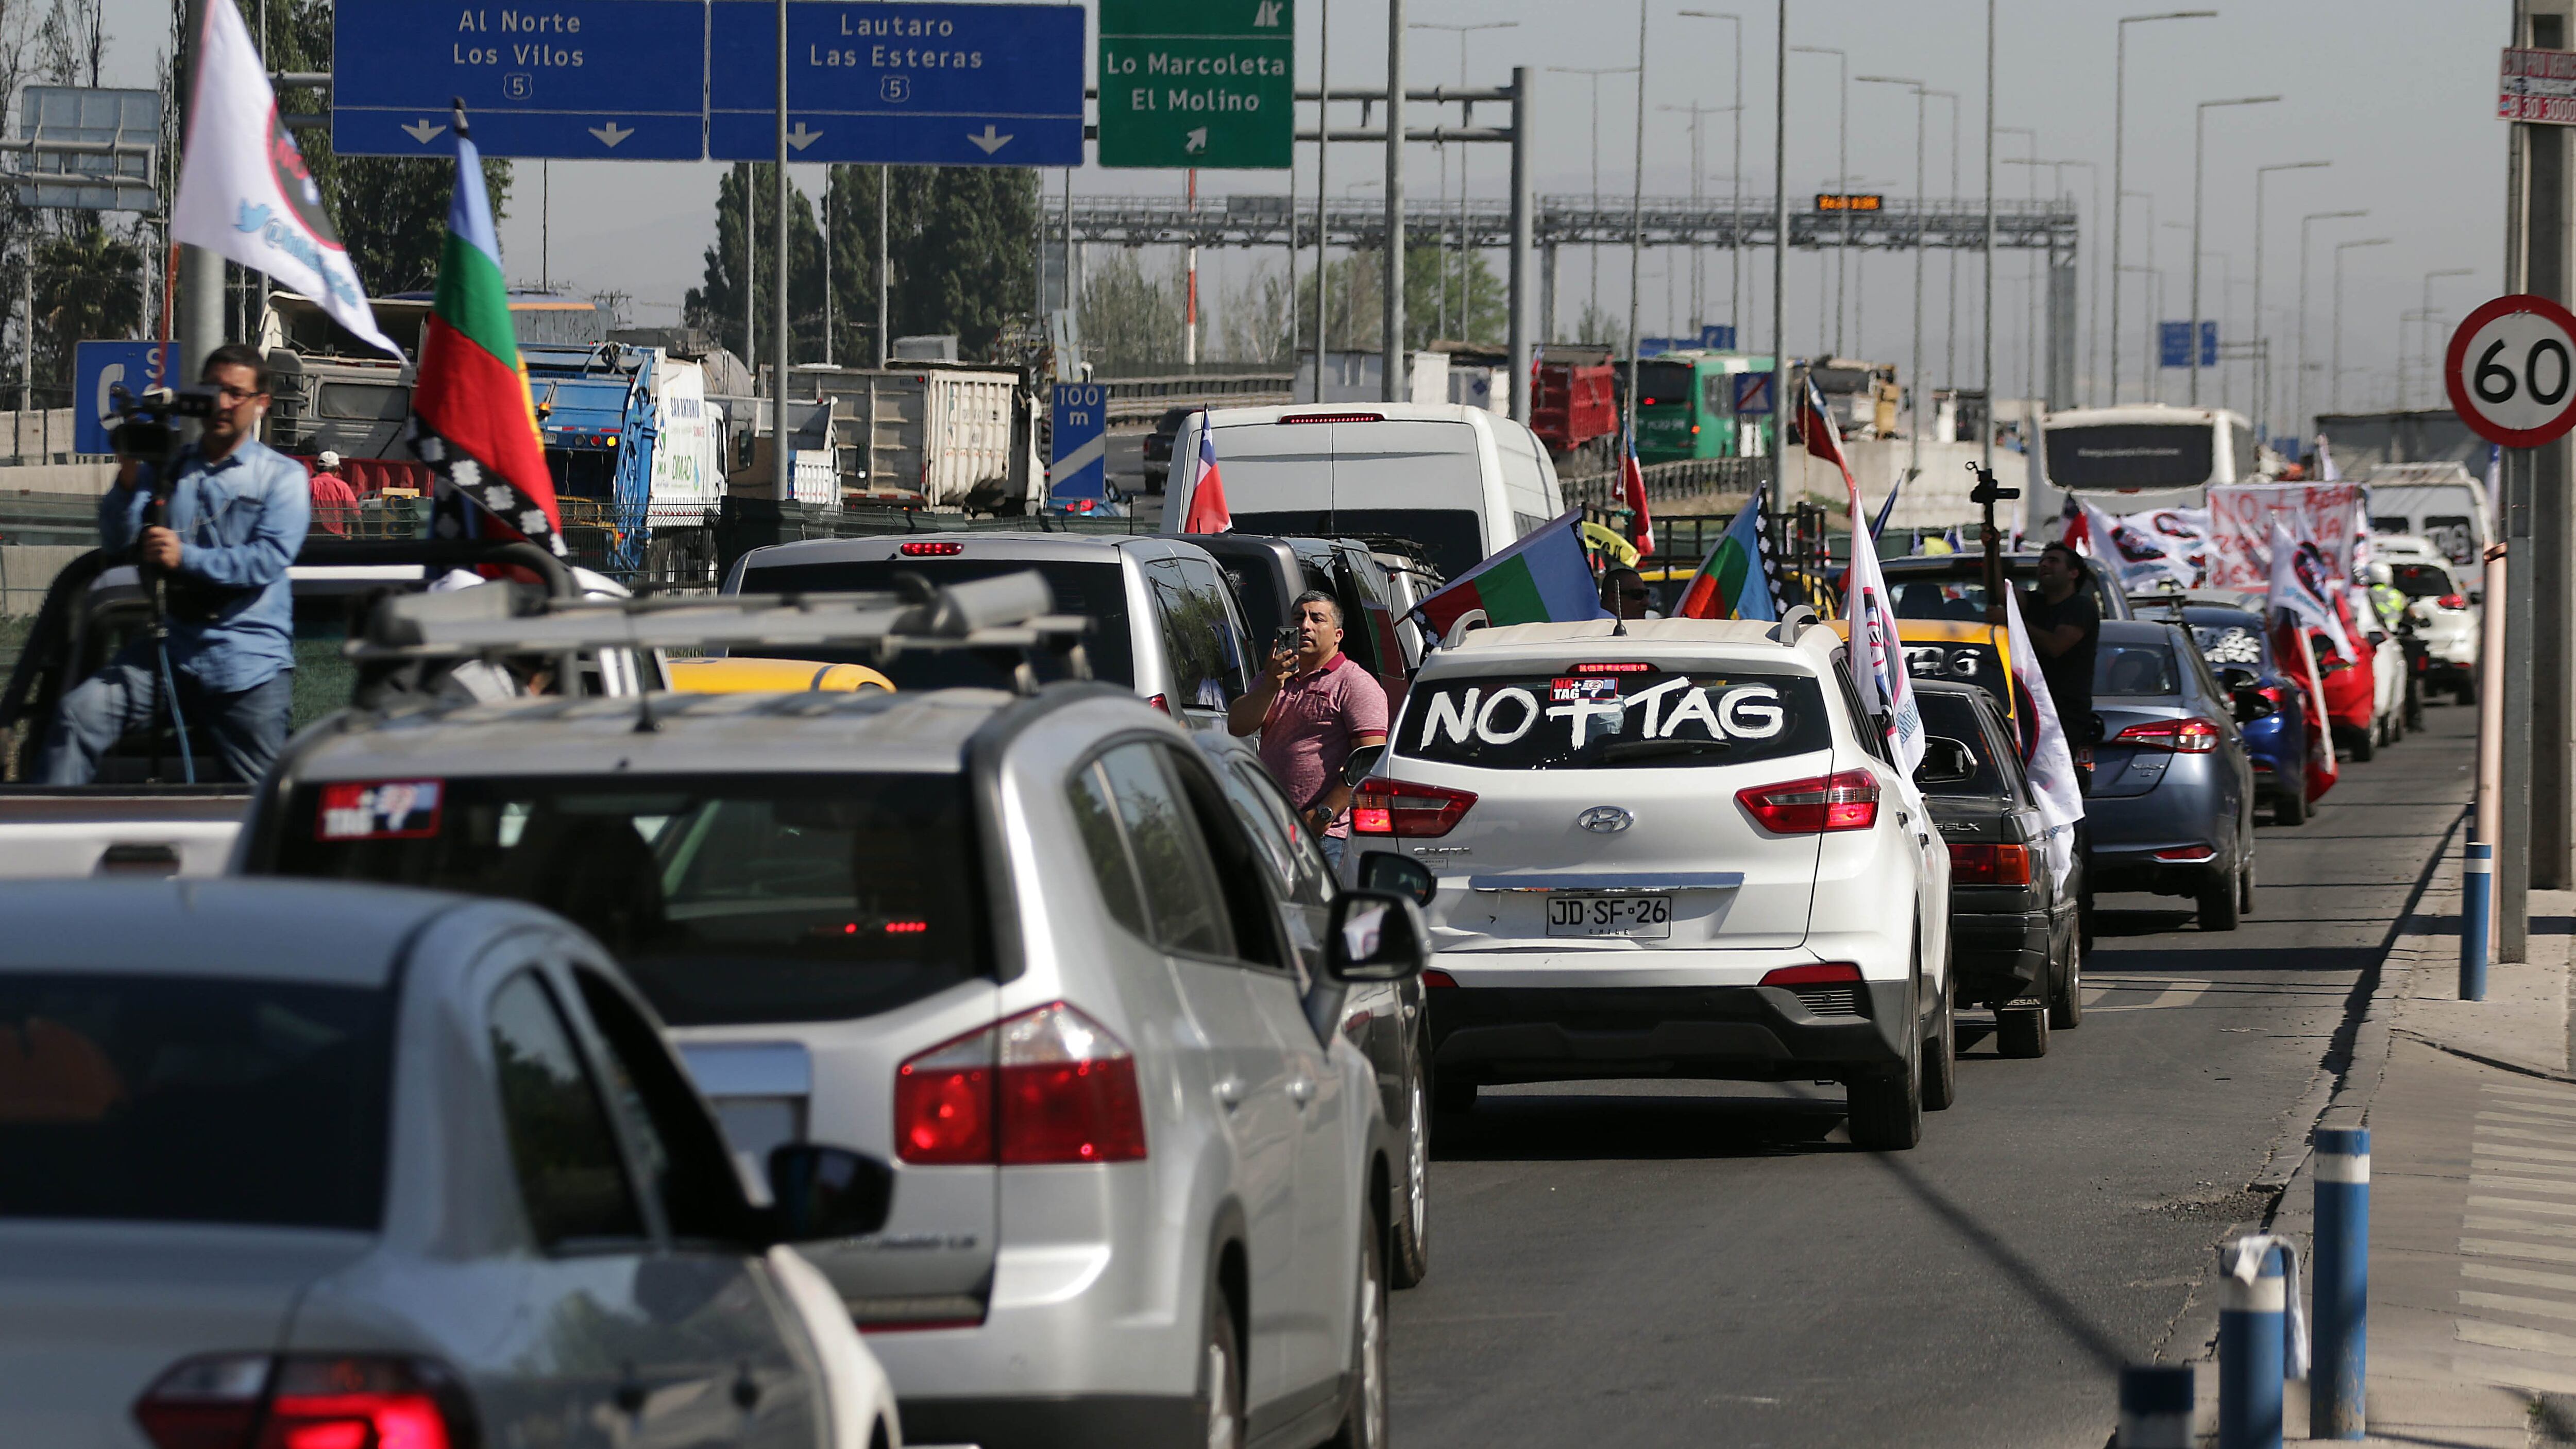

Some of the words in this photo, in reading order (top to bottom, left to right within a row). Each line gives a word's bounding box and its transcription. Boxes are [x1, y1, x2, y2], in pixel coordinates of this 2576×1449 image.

[459, 10, 487, 32] Al
[502, 10, 581, 33] Norte
[841, 13, 953, 37] Lautaro
[453, 43, 497, 65] Los
[513, 44, 584, 66] Vilos
[810, 44, 856, 66] Las
[872, 45, 982, 68] Esteras
[1107, 52, 1137, 75] Lo
[1148, 53, 1285, 76] Marcoleta
[513, 78, 524, 95] 5
[890, 80, 901, 98] 5
[1132, 88, 1156, 111] El
[1168, 89, 1260, 111] Molino
[2475, 338, 2570, 405] 60
[1060, 386, 1098, 406] 100
[670, 397, 680, 417] SAN
[680, 398, 700, 419] ANTONIO
[1069, 411, 1089, 426] m
[1554, 689, 1580, 700] TAG
[1624, 676, 1784, 739] TAG
